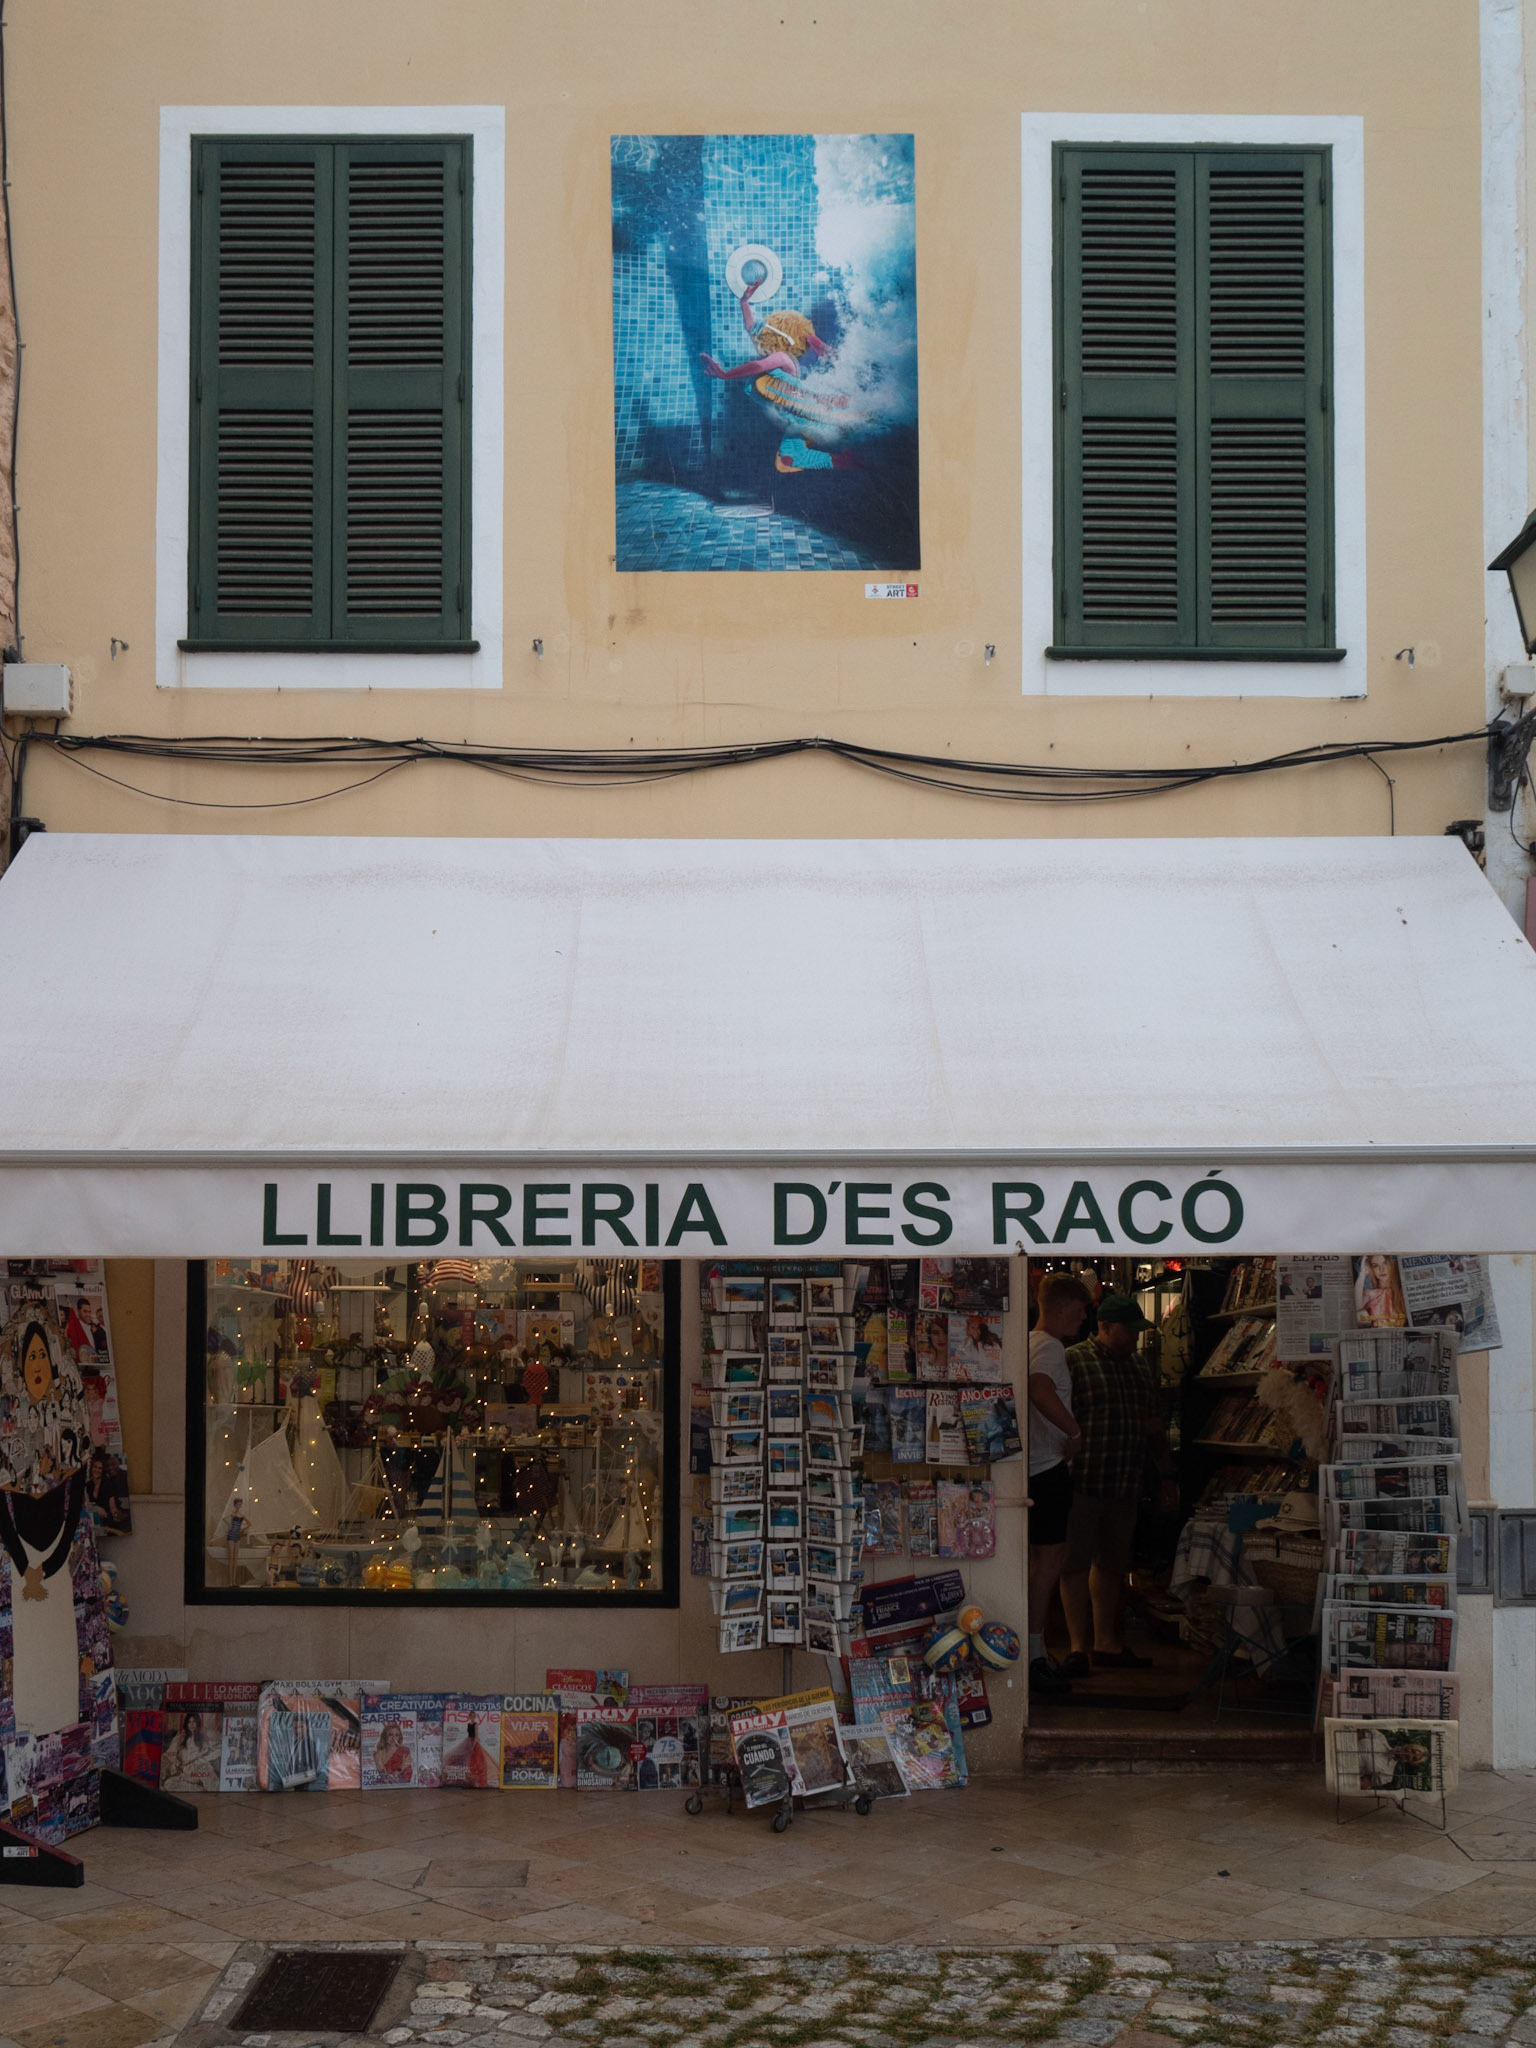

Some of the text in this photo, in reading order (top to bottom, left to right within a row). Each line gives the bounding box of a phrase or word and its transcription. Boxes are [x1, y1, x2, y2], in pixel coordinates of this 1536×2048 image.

[263, 1182, 728, 1246] LLIBRERIA
[991, 1169, 1245, 1244] RACÓ
[1442, 1347, 1452, 1363] EL
[1387, 1621, 1396, 1630] LA
[131, 1670, 169, 1682] MODA
[166, 1683, 211, 1699] ELLE
[213, 1684, 258, 1693] LO MEJOR
[379, 1699, 444, 1710] CREATIVIDA
[504, 1696, 556, 1711] COCINA
[577, 1708, 635, 1722] muy
[638, 1706, 674, 1716] muy
[361, 1713, 401, 1724] SABER
[444, 1711, 501, 1725] InSyle
[733, 1710, 783, 1732] muy
[511, 1721, 549, 1731] VIAJES
[660, 1740, 676, 1752] 75
[743, 1748, 775, 1766] CUANDO
[512, 1770, 546, 1781] ROMA
